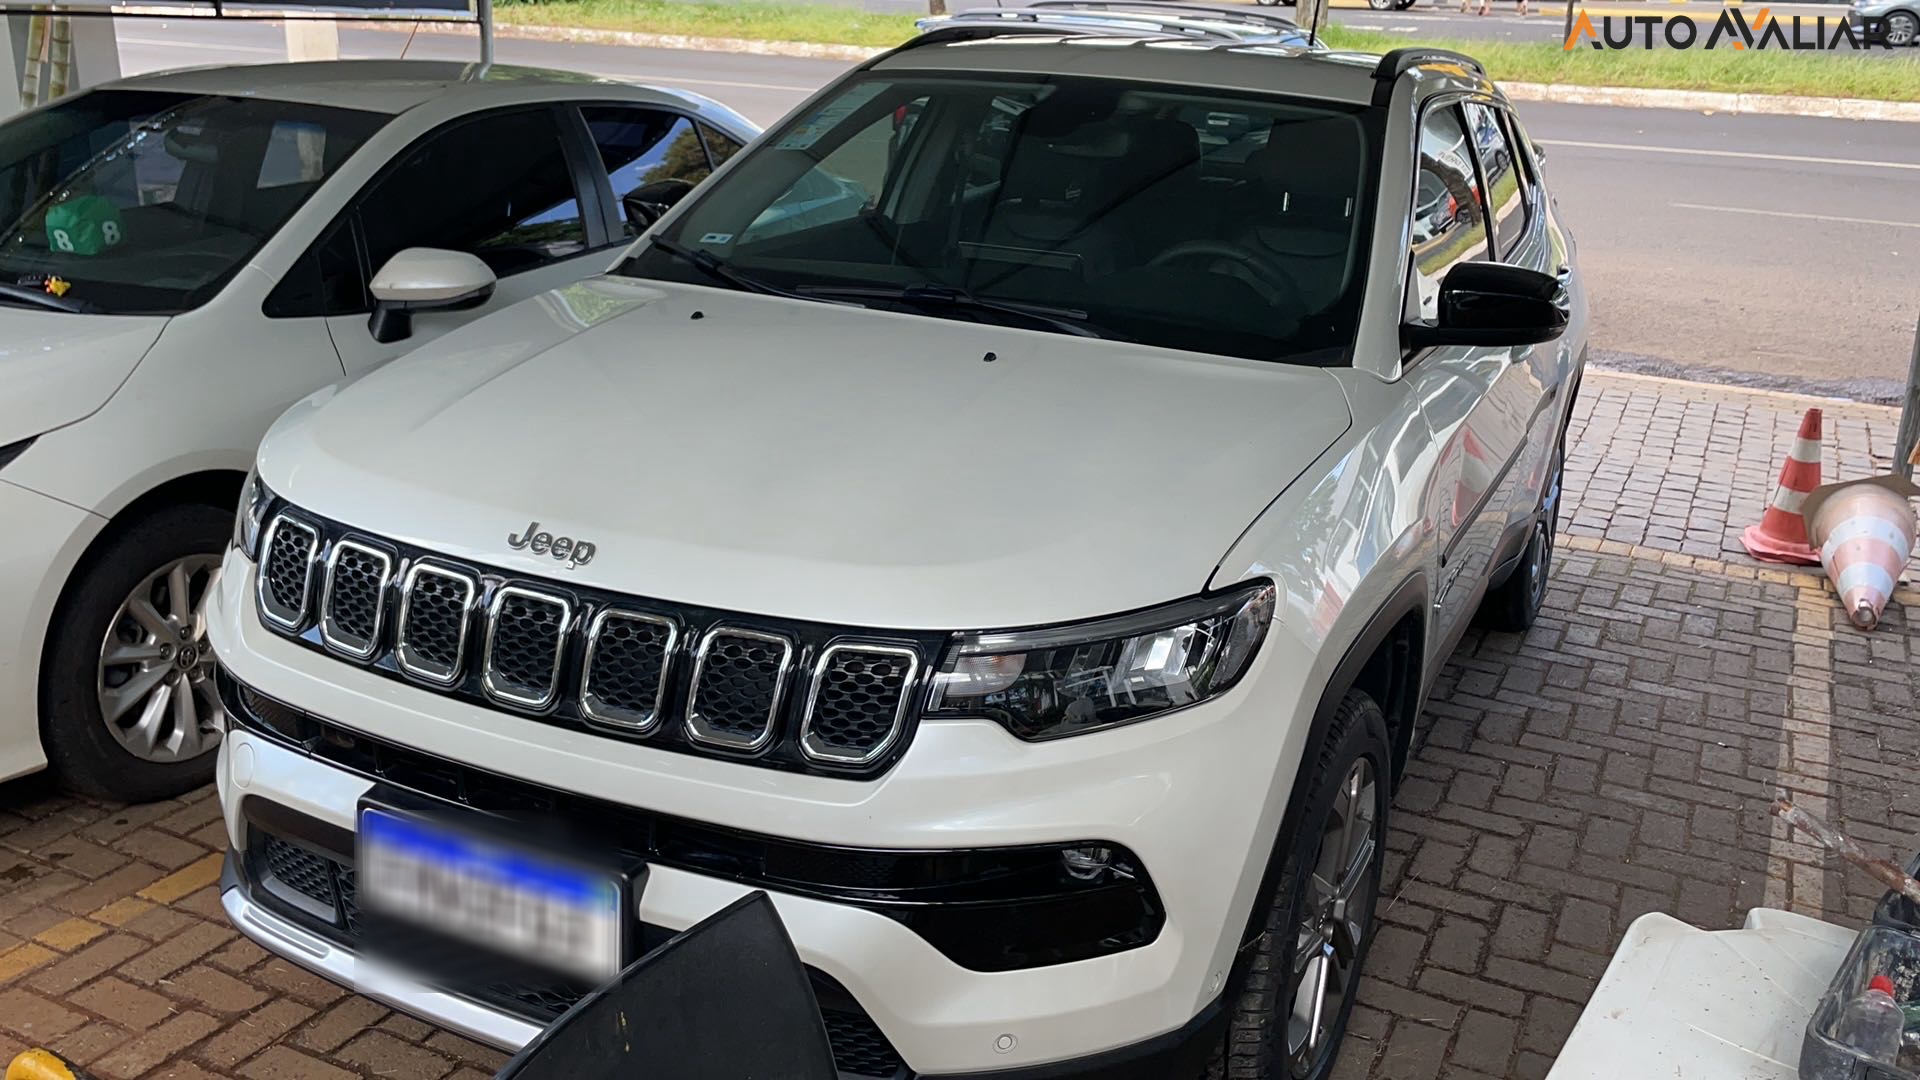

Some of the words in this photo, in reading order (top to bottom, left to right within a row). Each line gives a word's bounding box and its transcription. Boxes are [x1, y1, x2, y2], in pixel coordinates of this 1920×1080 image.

[53, 229, 74, 251] 8
[102, 220, 121, 245] 8
[507, 521, 596, 570] Jeep
